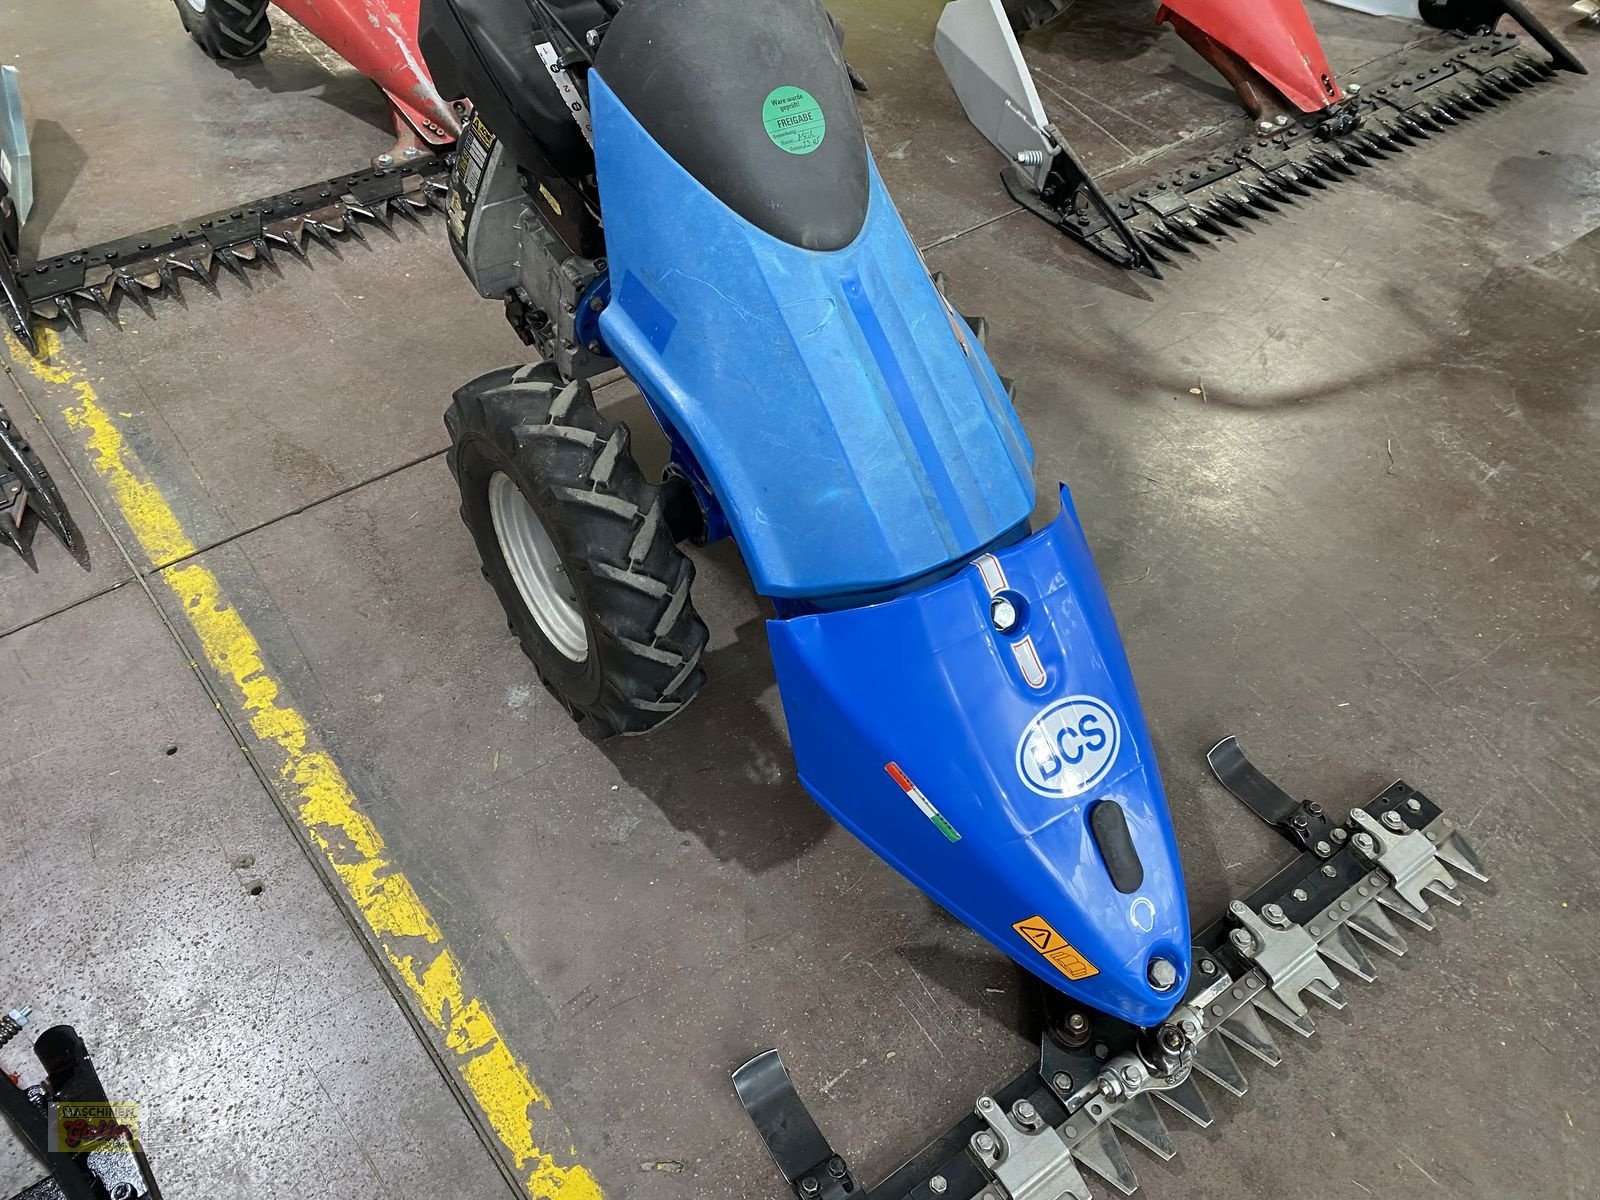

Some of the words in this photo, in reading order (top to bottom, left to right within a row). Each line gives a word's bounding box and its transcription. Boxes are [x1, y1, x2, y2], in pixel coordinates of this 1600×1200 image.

[771, 98, 786, 106] Ware
[787, 94, 803, 102] wurde
[777, 112, 813, 128] FREIGABE
[1030, 714, 1107, 781] BCS
